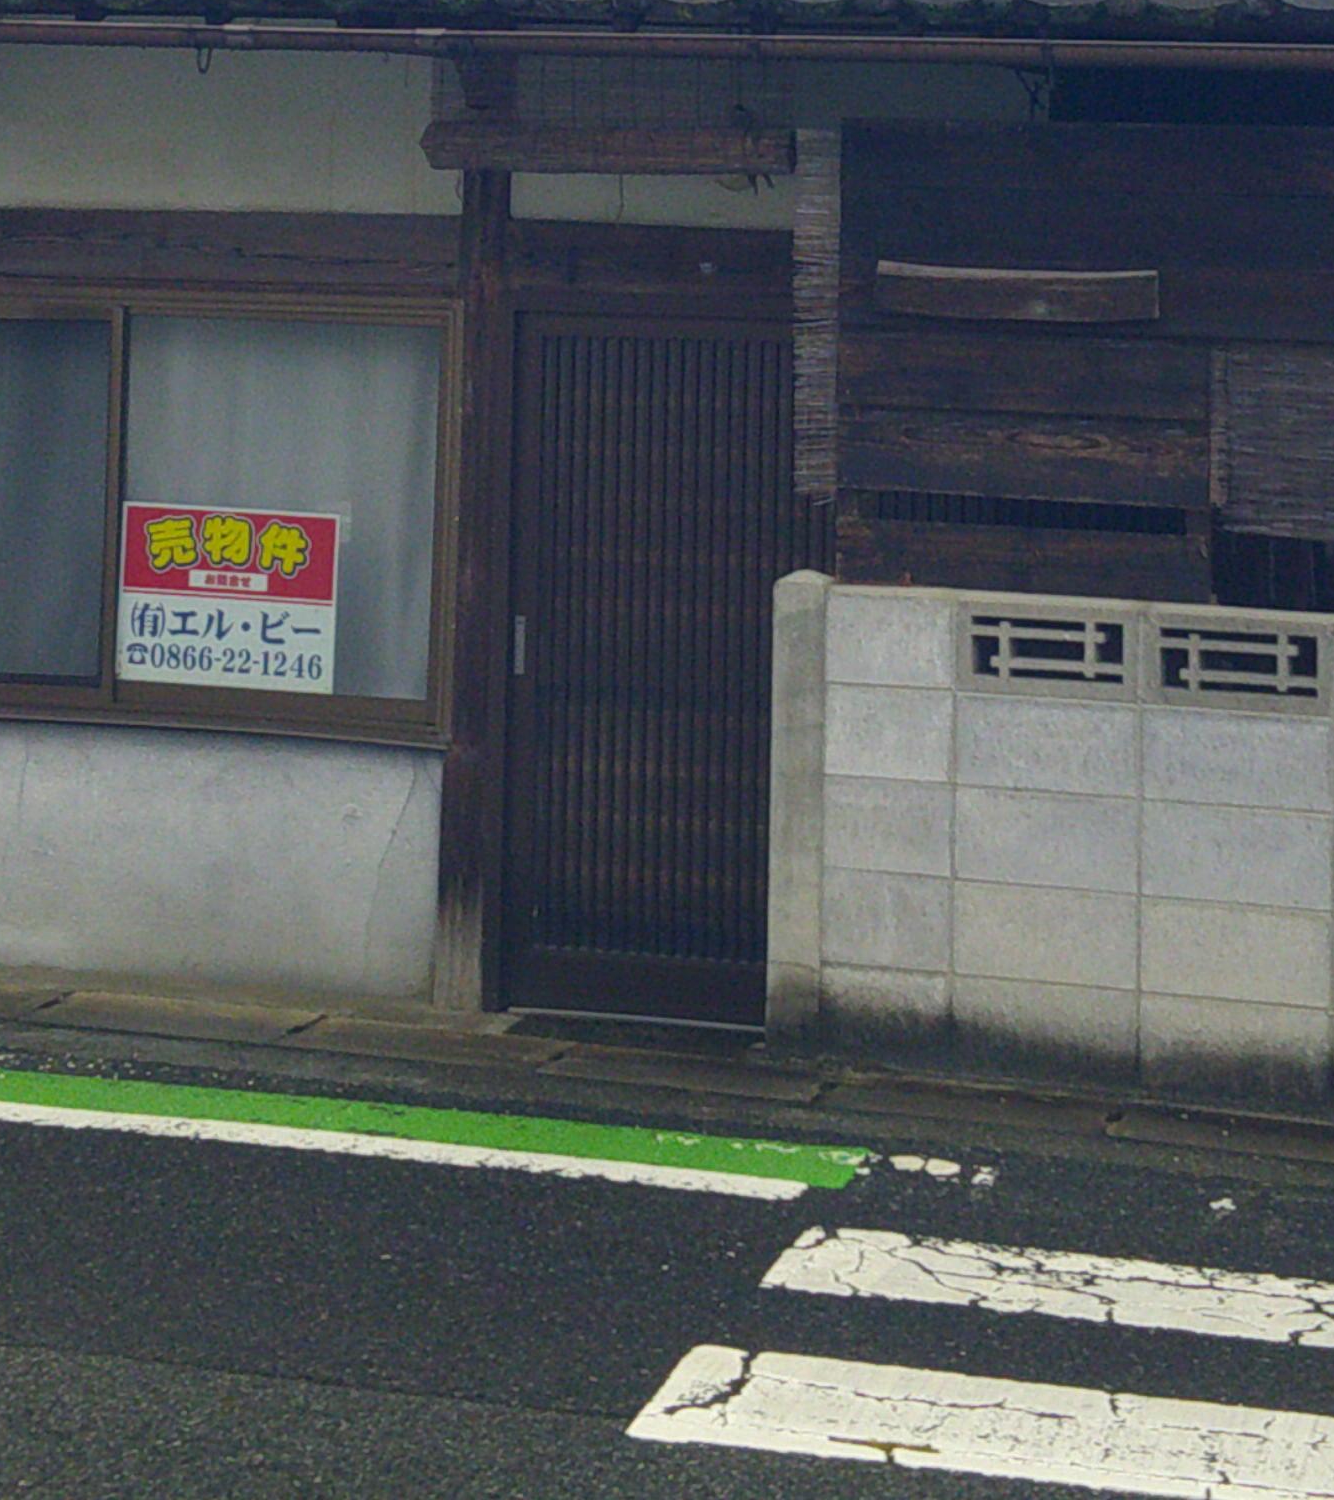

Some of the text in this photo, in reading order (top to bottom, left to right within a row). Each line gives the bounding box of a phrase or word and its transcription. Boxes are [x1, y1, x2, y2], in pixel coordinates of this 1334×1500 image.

[146, 514, 309, 576] 売物件
[150, 643, 323, 680] 0866-22-1246
